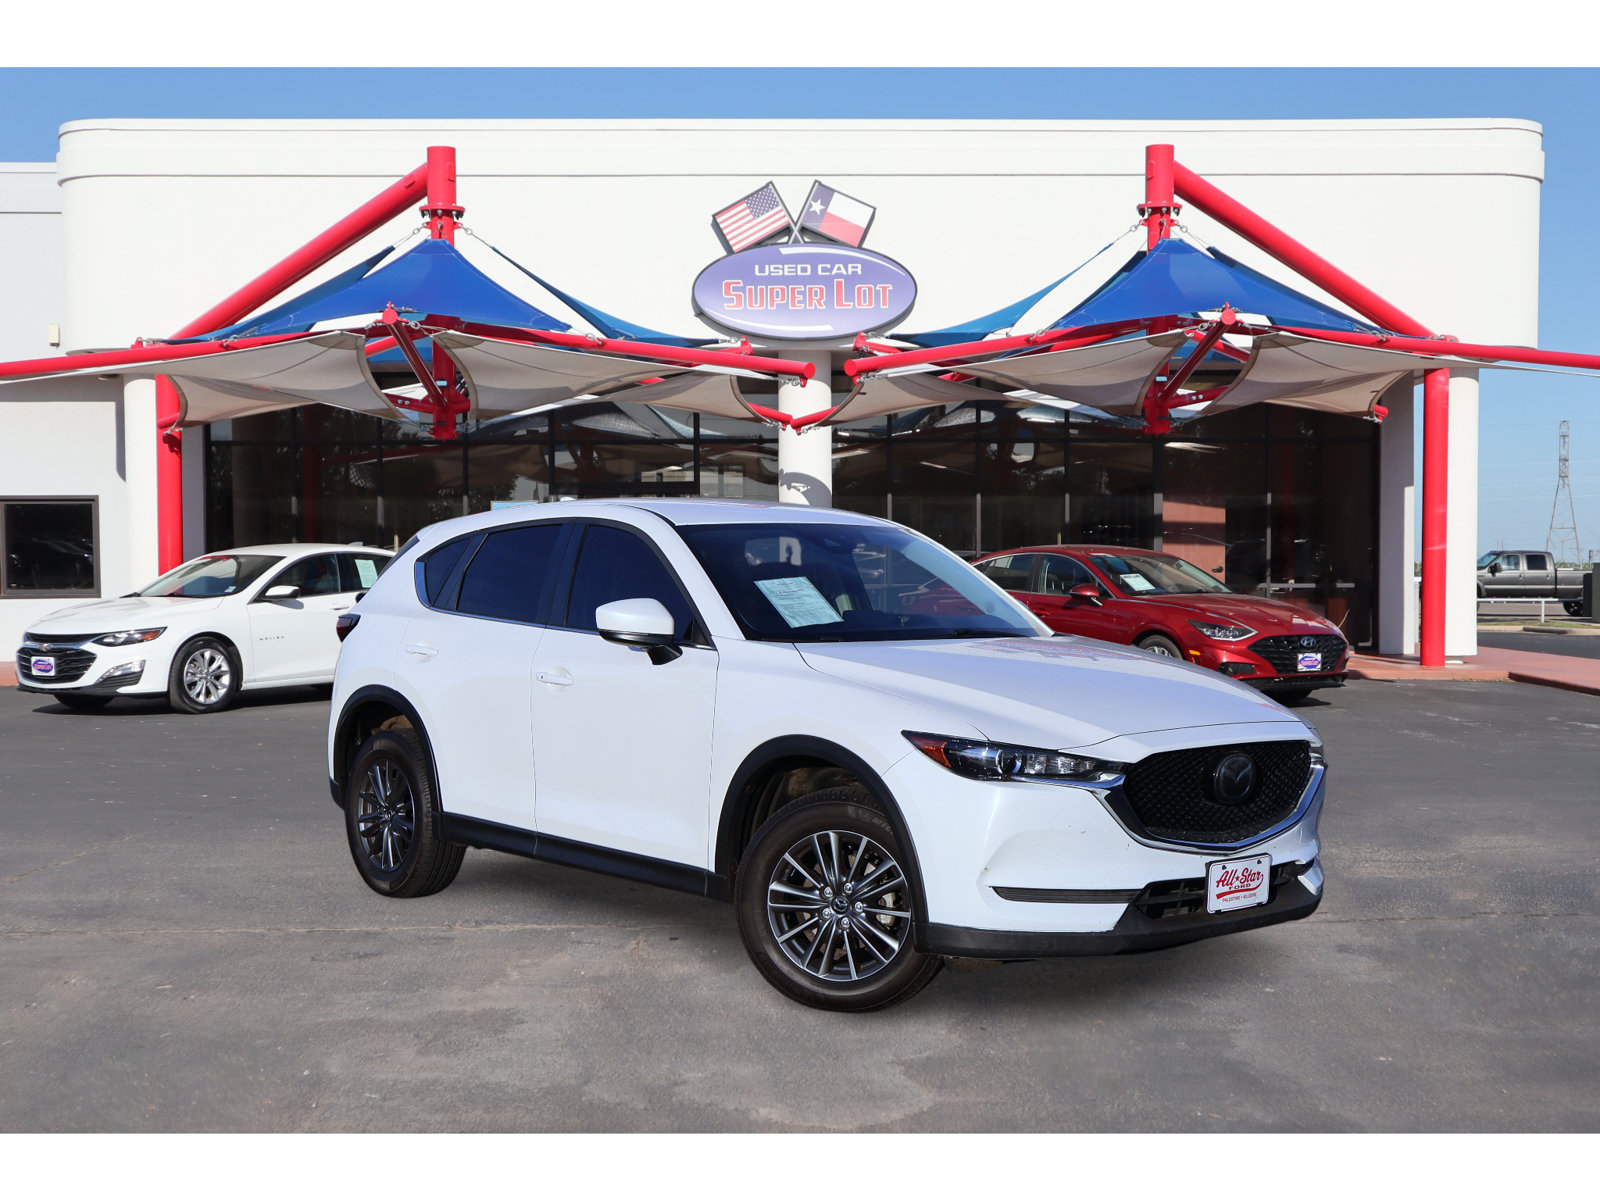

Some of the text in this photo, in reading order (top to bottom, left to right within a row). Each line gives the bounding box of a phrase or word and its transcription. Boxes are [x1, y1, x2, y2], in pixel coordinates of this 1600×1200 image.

[754, 263, 862, 276] USED CAR
[723, 278, 893, 310] SUPER LOT
